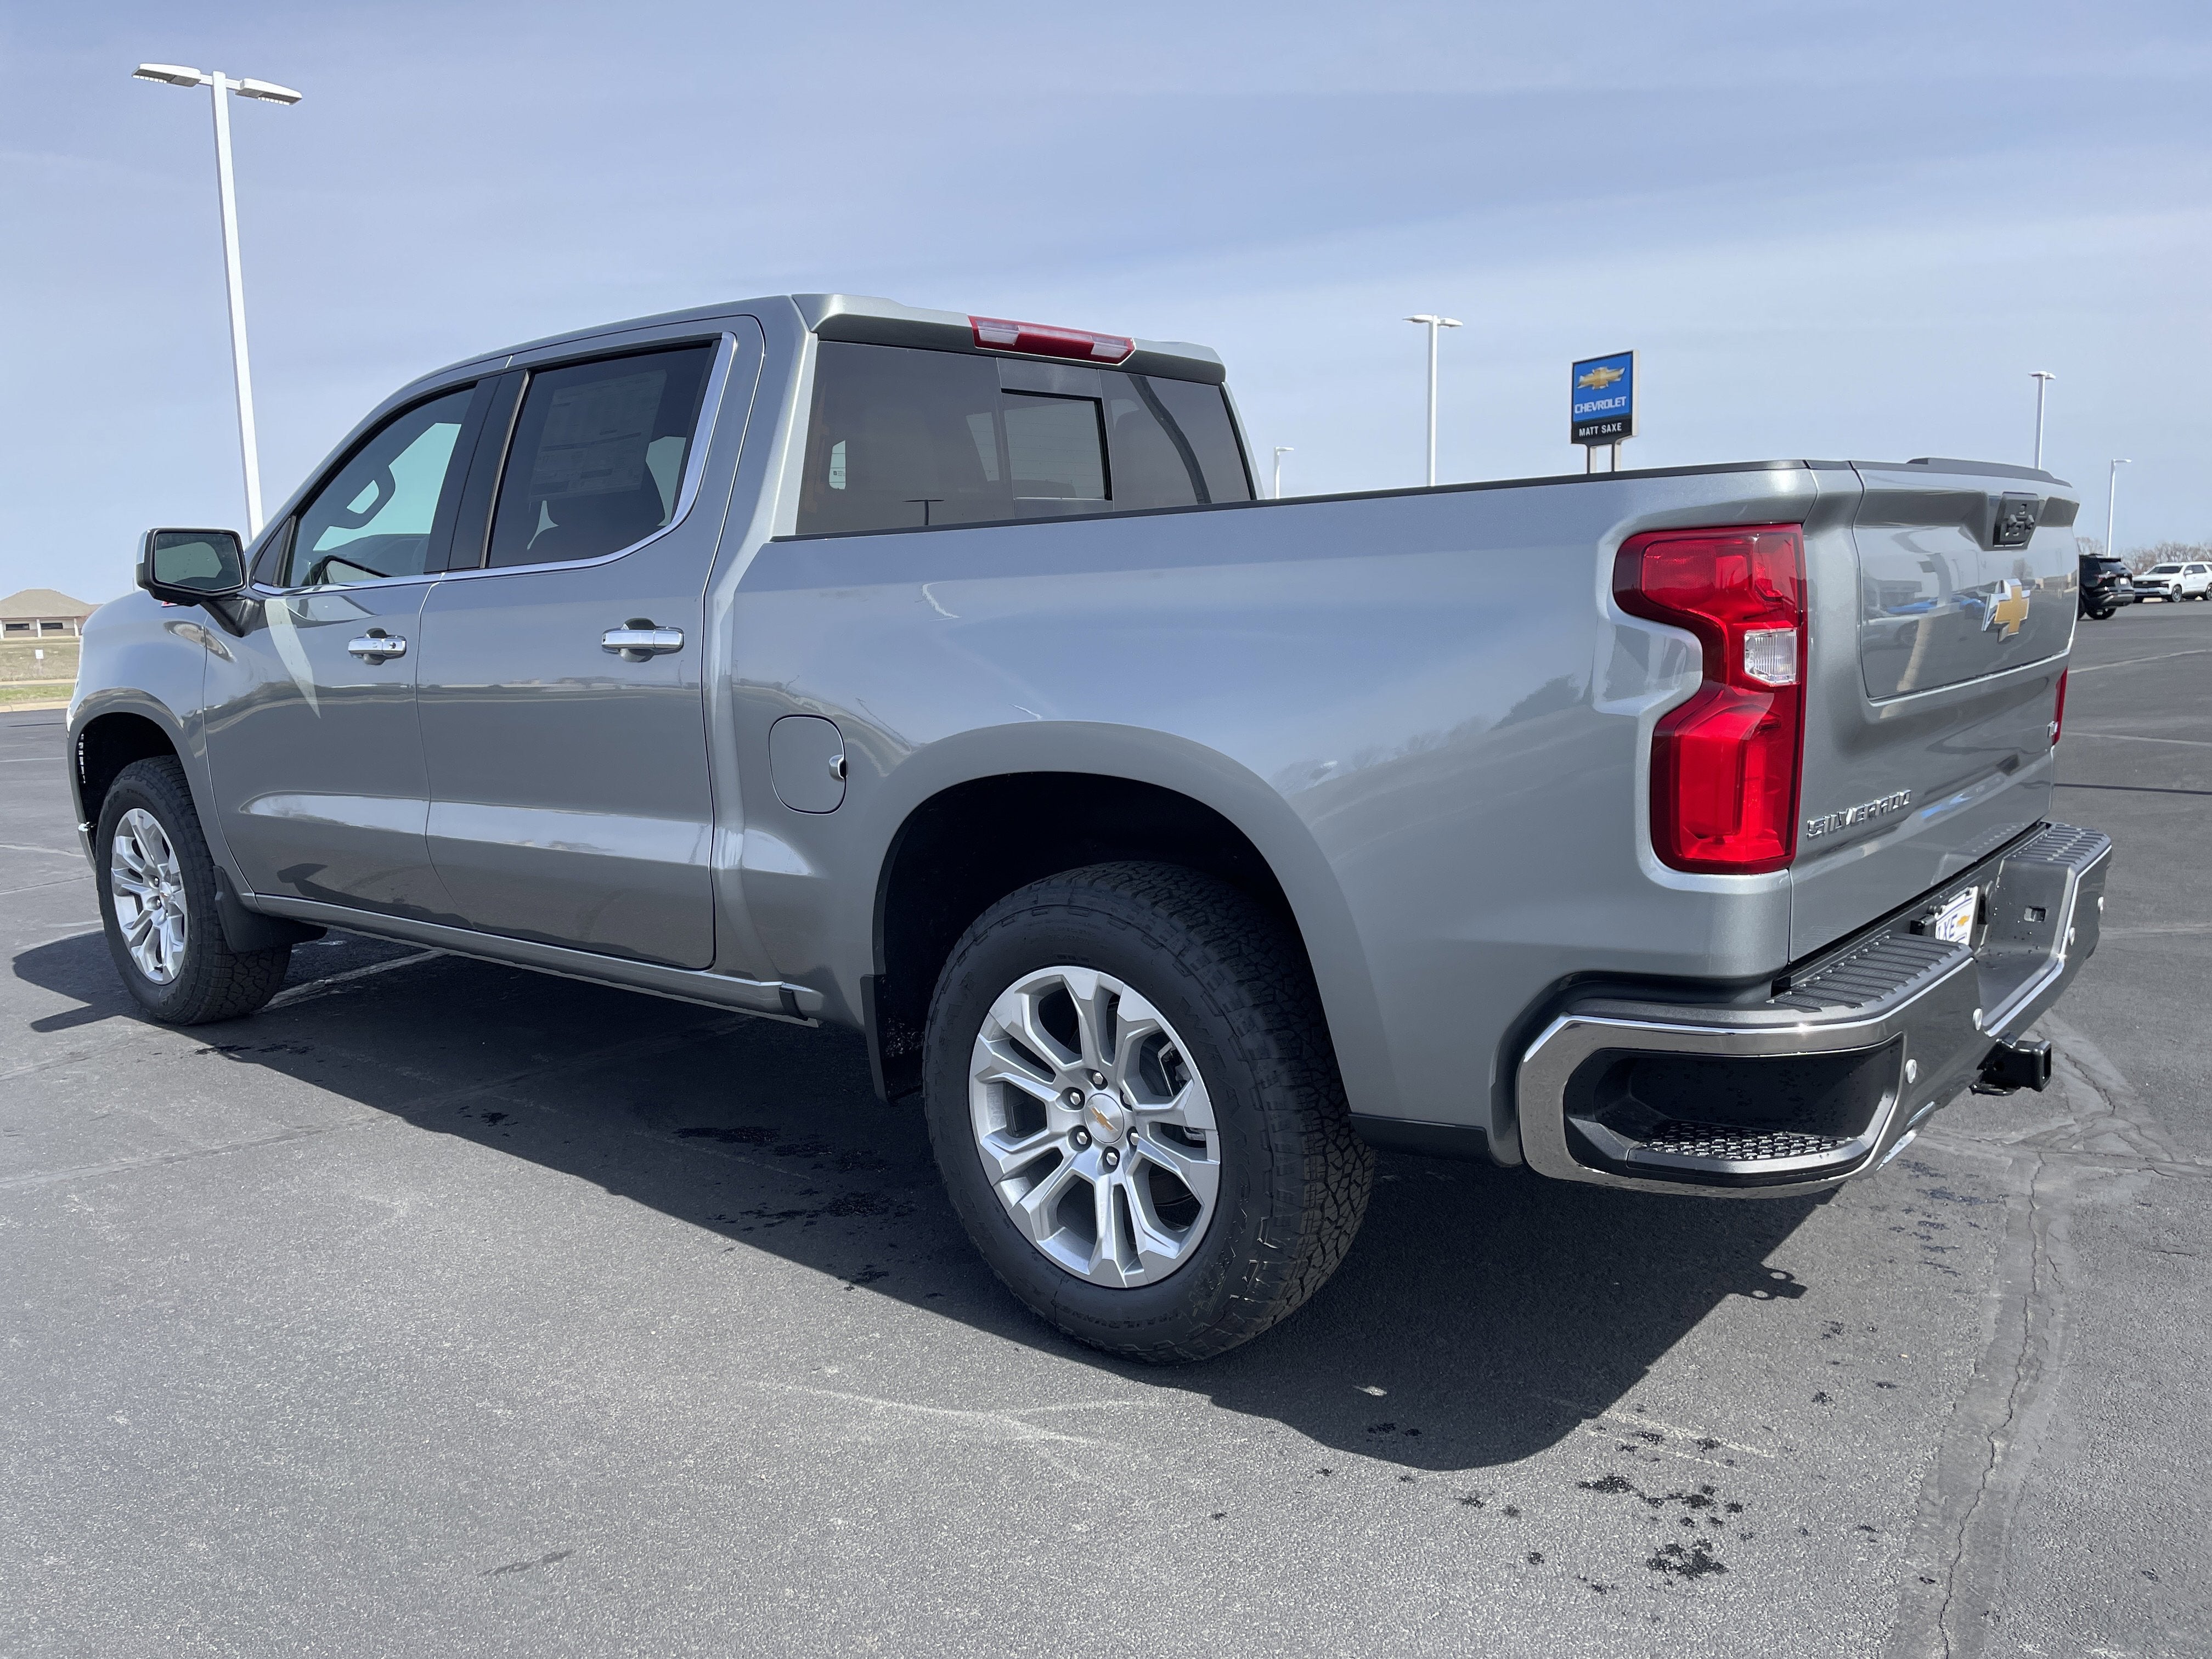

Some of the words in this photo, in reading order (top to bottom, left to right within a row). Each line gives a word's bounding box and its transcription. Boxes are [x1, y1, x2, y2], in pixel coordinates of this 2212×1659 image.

[1575, 396, 1627, 414] CHEVROLET
[1579, 426, 1599, 437] MATT
[1601, 422, 1622, 434] SAXE
[1806, 789, 1911, 838] SILVERADO
